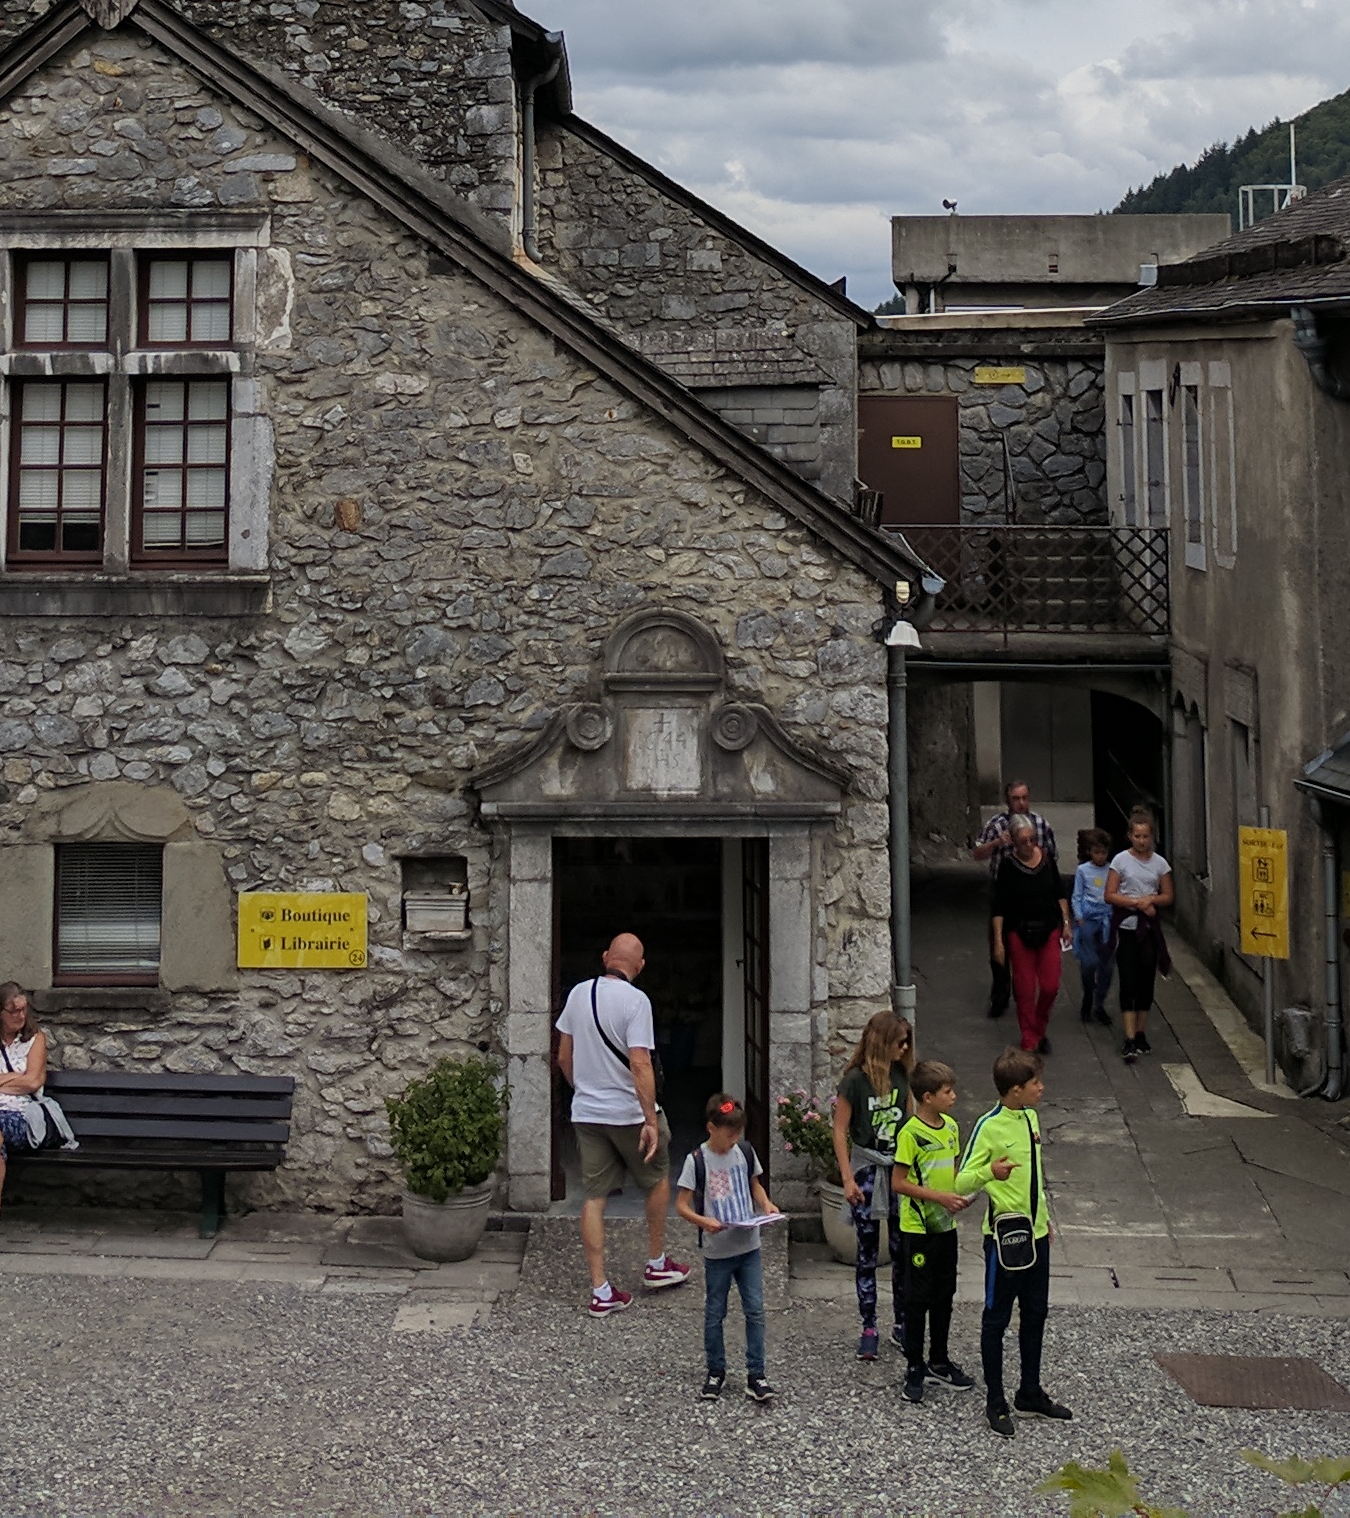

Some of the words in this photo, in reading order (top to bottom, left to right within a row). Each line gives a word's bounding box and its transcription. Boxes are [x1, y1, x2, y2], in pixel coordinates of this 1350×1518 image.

[280, 907, 351, 925] Boutique
[280, 935, 350, 951] Librairie
[352, 953, 363, 962] 24
